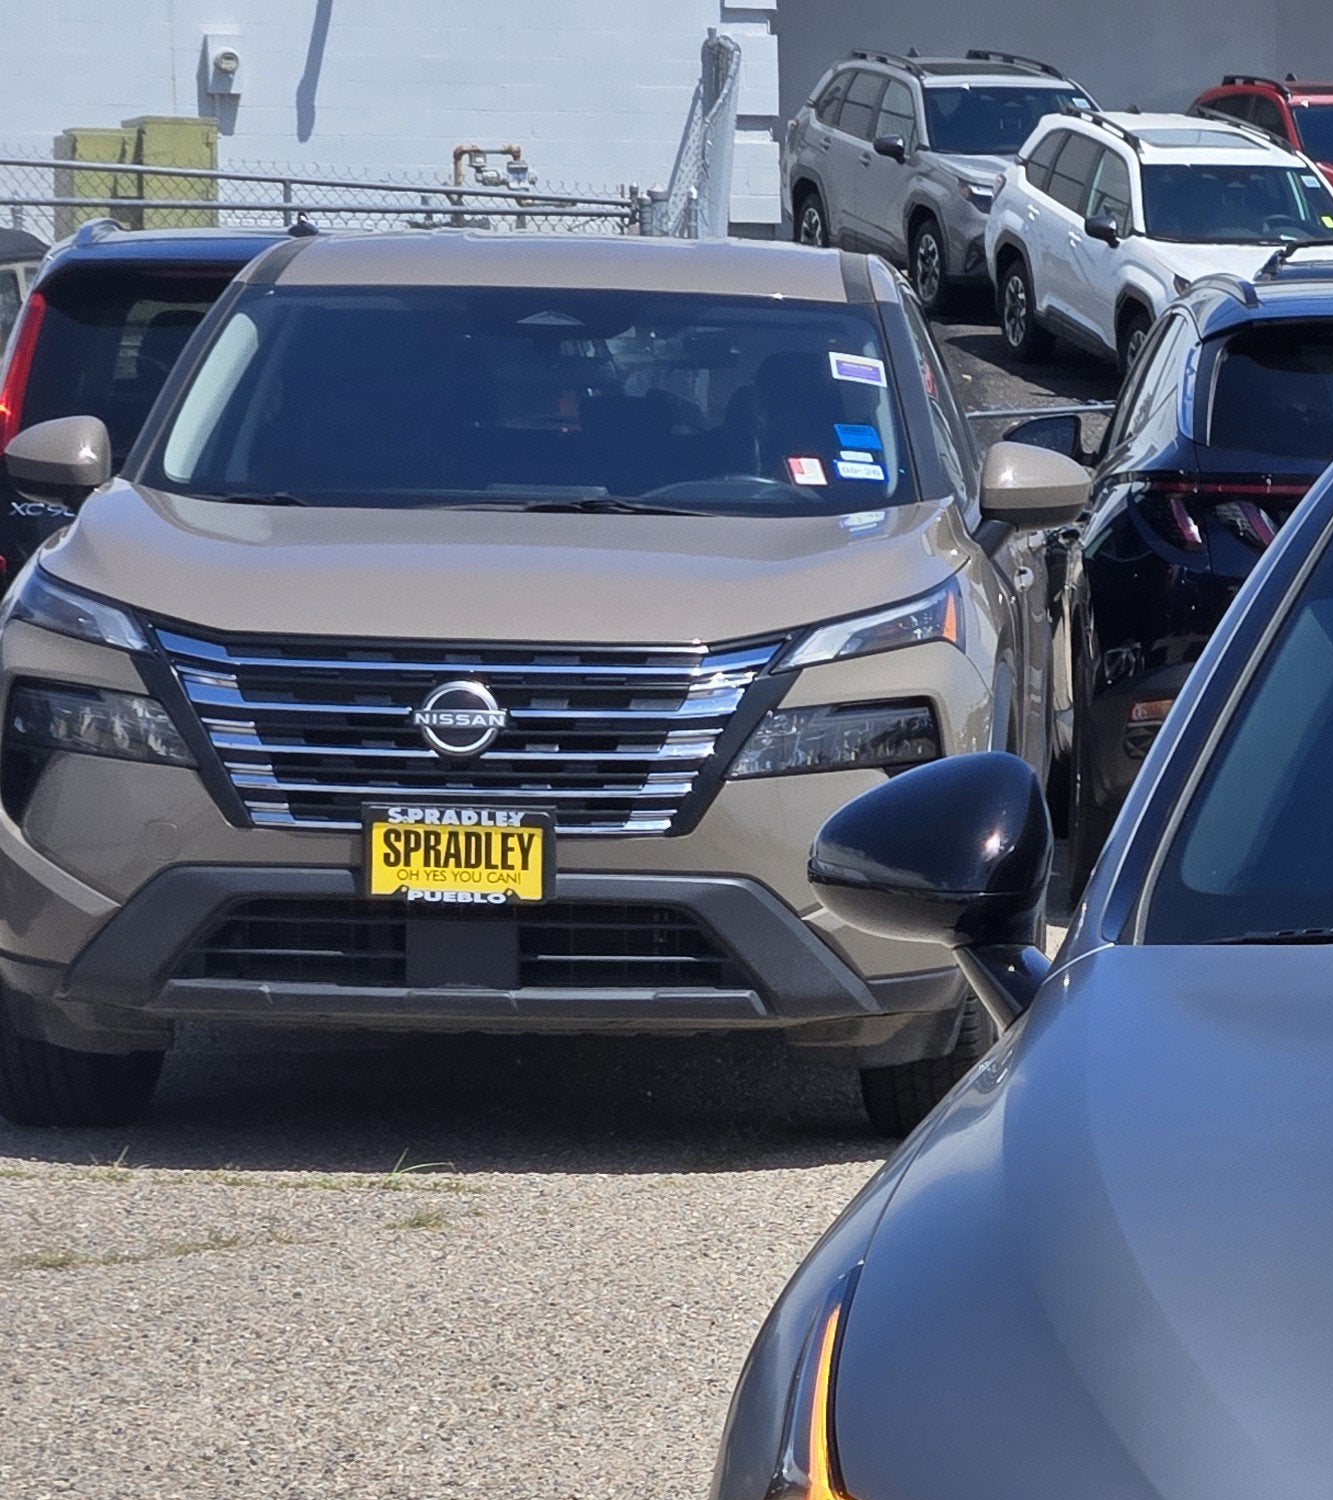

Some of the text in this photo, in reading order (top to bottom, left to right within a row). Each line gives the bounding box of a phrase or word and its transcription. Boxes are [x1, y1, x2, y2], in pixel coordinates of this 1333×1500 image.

[414, 713, 505, 727] NISSAN
[388, 807, 525, 827] SPRADLEY
[383, 828, 535, 871] SPRADLEY
[397, 869, 522, 885] OH YES YOU CAN!
[407, 889, 507, 904] PUEBLO
